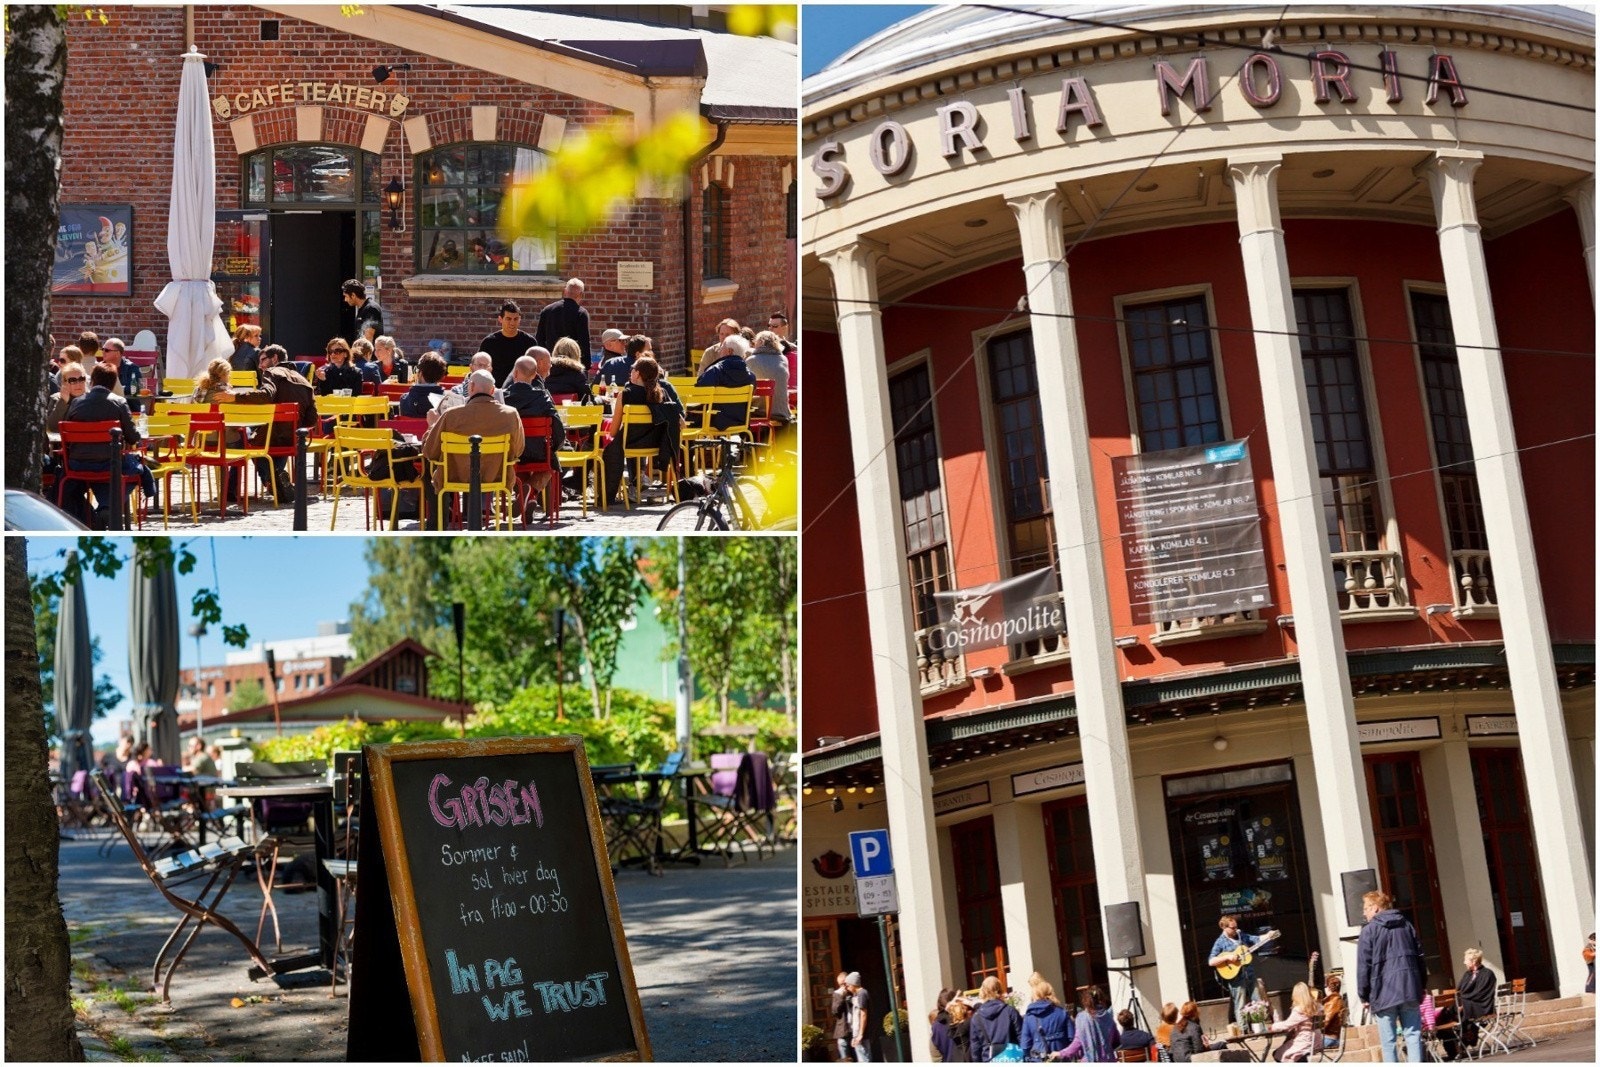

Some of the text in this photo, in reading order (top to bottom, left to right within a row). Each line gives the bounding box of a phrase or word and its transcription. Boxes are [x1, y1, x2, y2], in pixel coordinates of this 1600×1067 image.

[234, 78, 387, 112] CAFÉ TEATER
[811, 50, 1469, 200] SORIA MORIA
[1129, 545, 1156, 555] KAFKA
[1196, 536, 1209, 545] 4.1
[928, 605, 1062, 651] Cosmopolite
[441, 844, 501, 866] Sommer
[860, 837, 881, 871] P
[502, 866, 529, 886] hver
[536, 860, 561, 896] dag
[460, 902, 485, 927] fra
[490, 897, 517, 919] 11:00
[529, 894, 568, 915] 00:30
[481, 971, 609, 1022] WE TRUST
